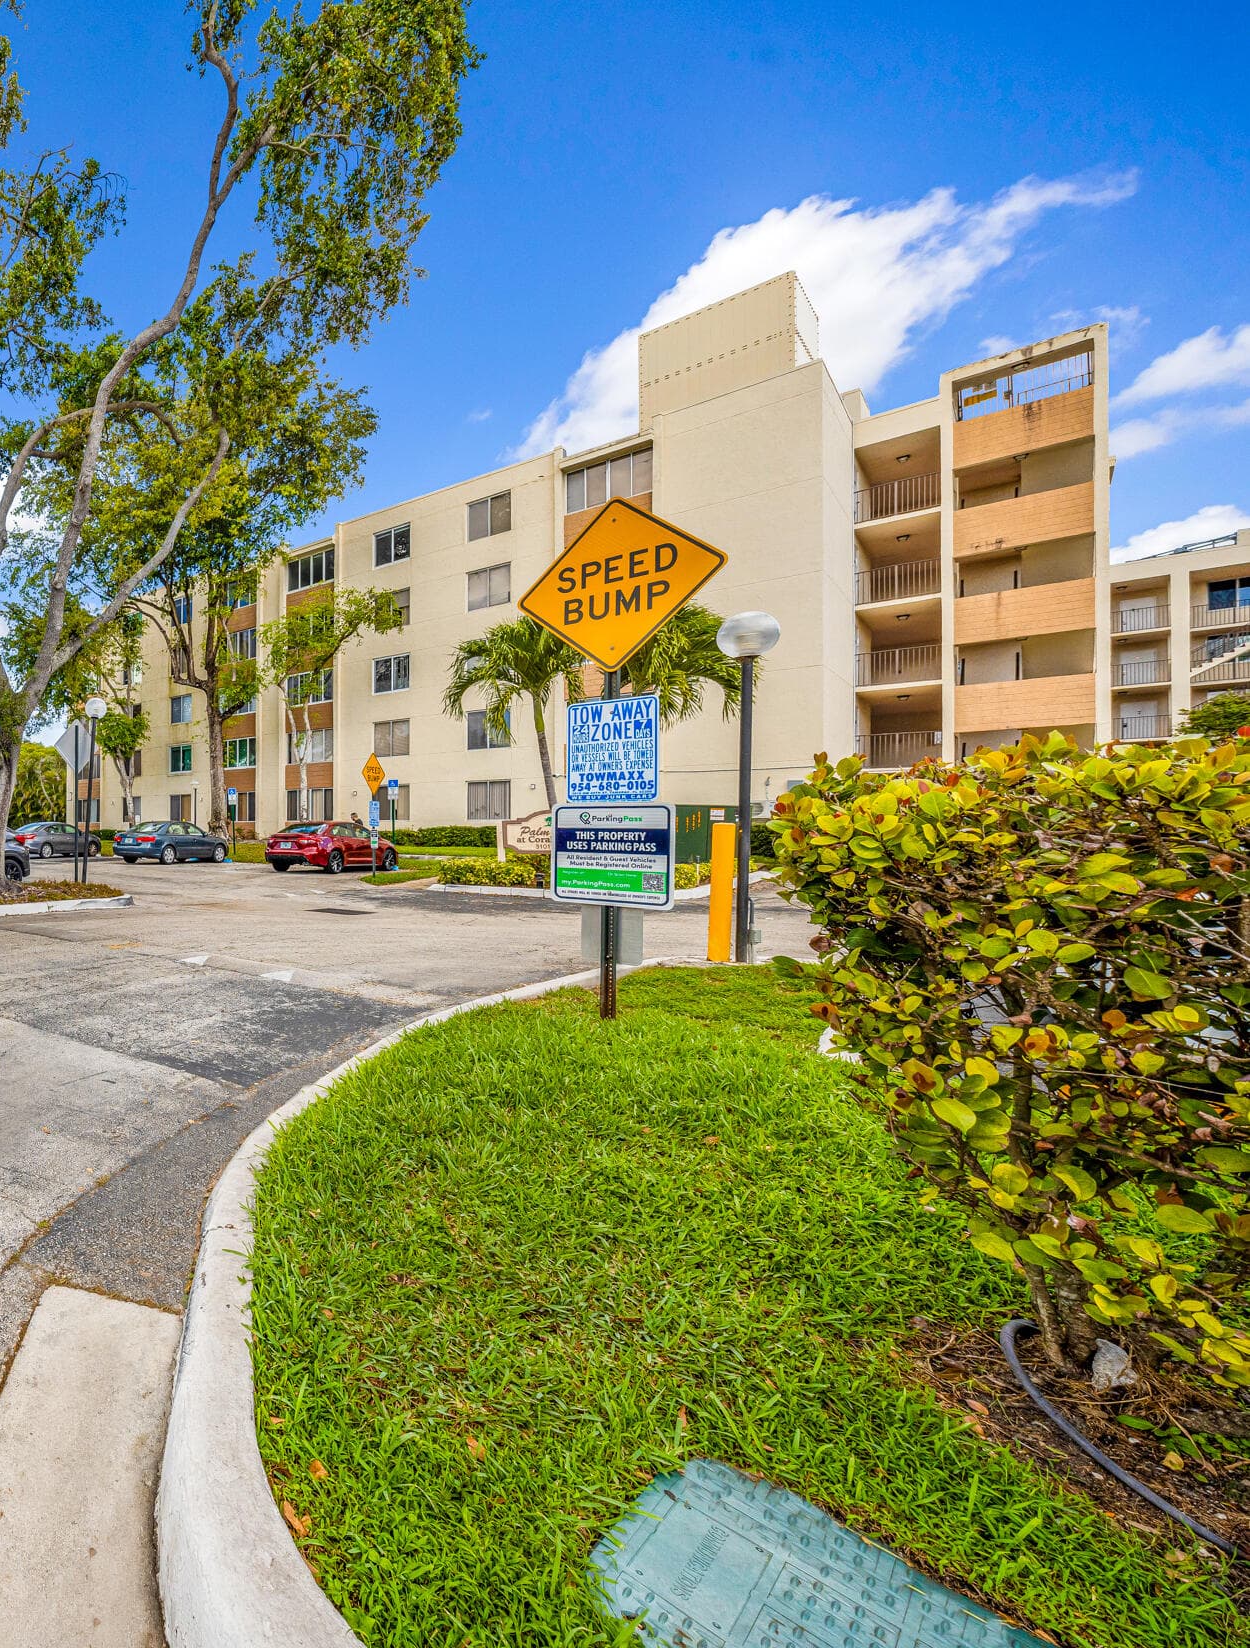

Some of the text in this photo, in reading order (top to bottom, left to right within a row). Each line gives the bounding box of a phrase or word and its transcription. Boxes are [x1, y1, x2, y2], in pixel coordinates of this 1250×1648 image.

[557, 543, 678, 593] SPEED
[564, 580, 670, 625] BUMP
[572, 700, 653, 725] TOW AWAY
[573, 725, 589, 735] 24
[638, 720, 647, 729] 7
[591, 721, 632, 741] ZONE
[636, 728, 651, 738] DAYS
[572, 739, 654, 753] UNAUTHORIZED VEHICLES
[572, 750, 654, 763] OR VESSELS WILL BE TOWED
[367, 766, 381, 774] SPEED
[572, 763, 586, 772] AWAY
[589, 762, 596, 771] AT
[625, 760, 654, 770] EXPENSE
[579, 770, 645, 782] TOWMAXX
[571, 780, 654, 792] 954-680-0105
[575, 831, 646, 841] THIS PROPERTY
[566, 841, 588, 850] USES
[596, 861, 629, 869] Registered
